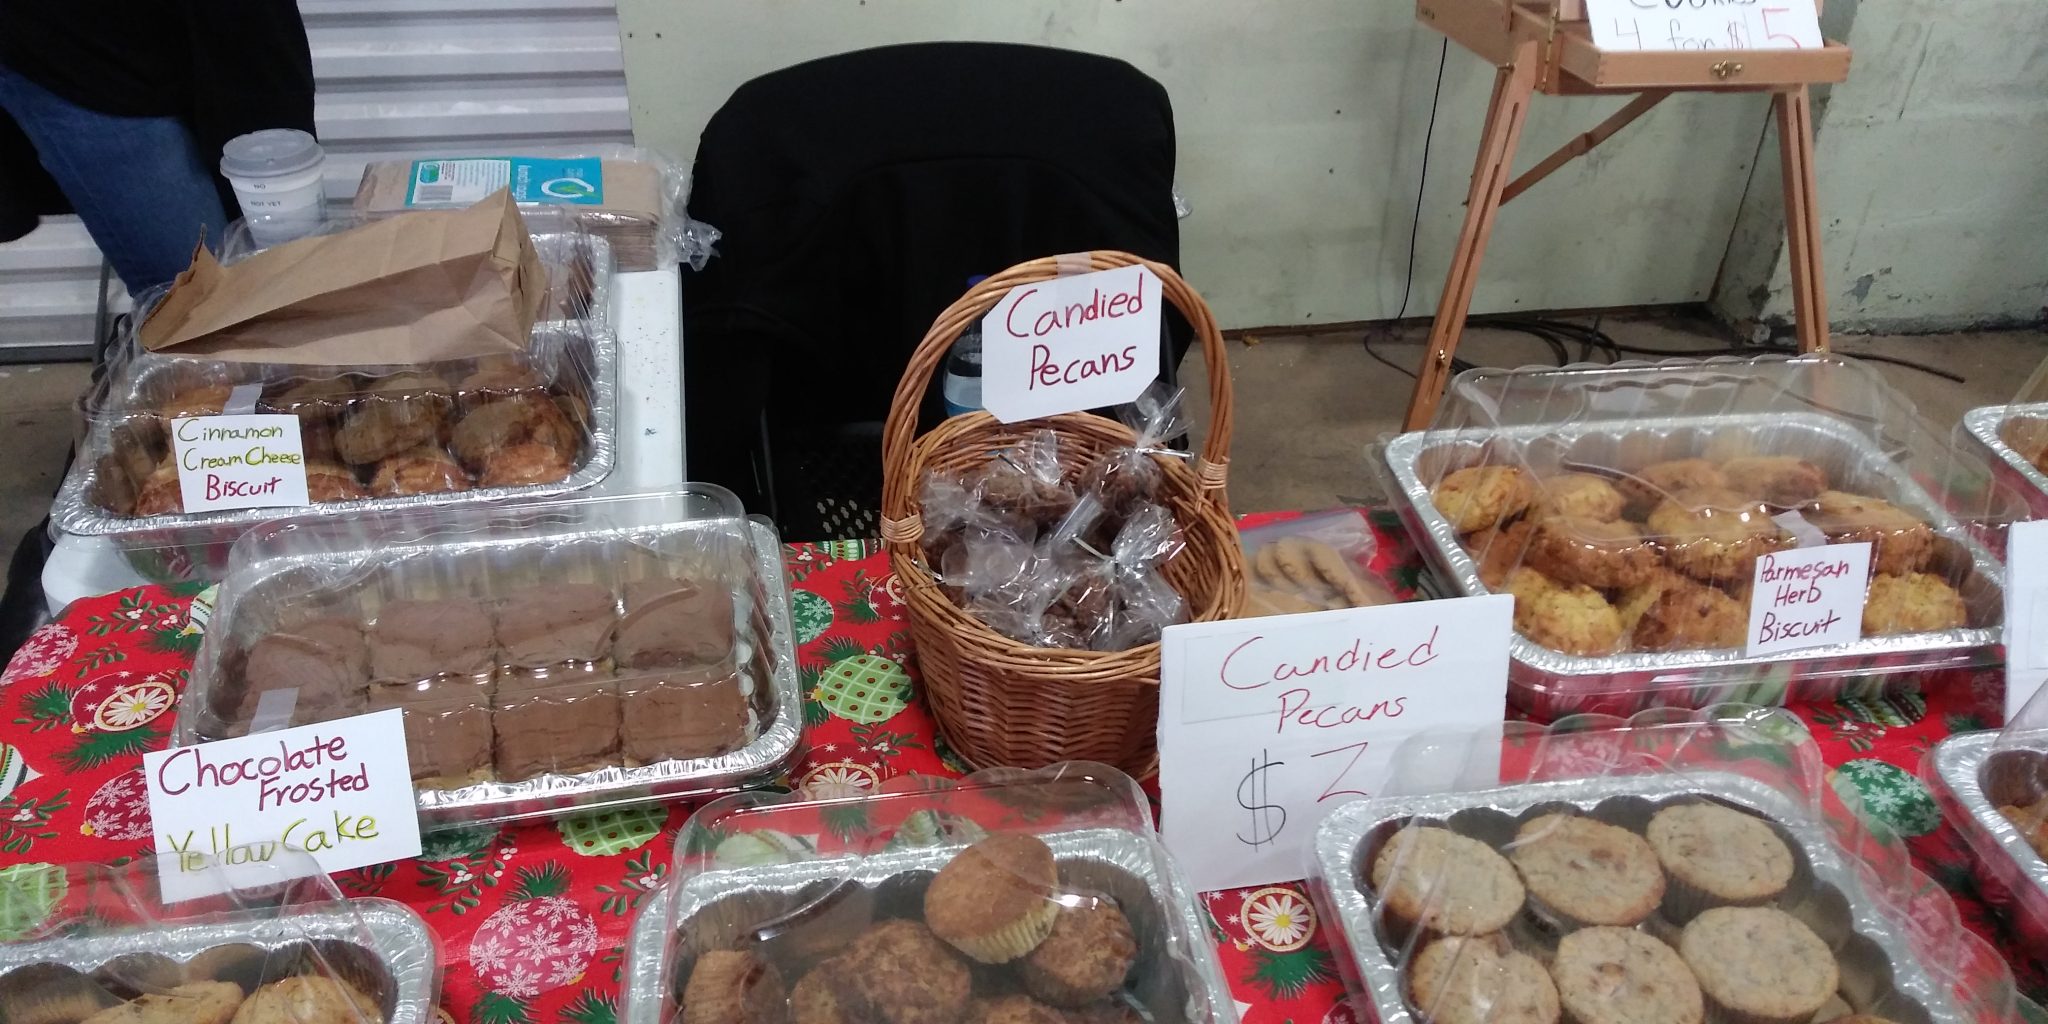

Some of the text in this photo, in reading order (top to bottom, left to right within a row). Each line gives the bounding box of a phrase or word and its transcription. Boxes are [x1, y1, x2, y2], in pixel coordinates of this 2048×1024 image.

[1613, 16, 1642, 49] 4
[1006, 272, 1143, 338] Candied
[1029, 344, 1137, 390] Pecans
[177, 418, 283, 442] Cinnamon
[183, 446, 301, 471] Cream Cheese
[205, 474, 282, 501] Biscuit
[1760, 554, 1849, 583] Parmesan
[1774, 579, 1822, 607] Herb
[1758, 609, 1841, 645] Biscuit
[1220, 625, 1439, 690] Candied
[1277, 688, 1407, 733] Pecans
[158, 735, 347, 795] Chocolate
[258, 762, 370, 812] Frosted
[166, 810, 380, 873] Yellow Cake
